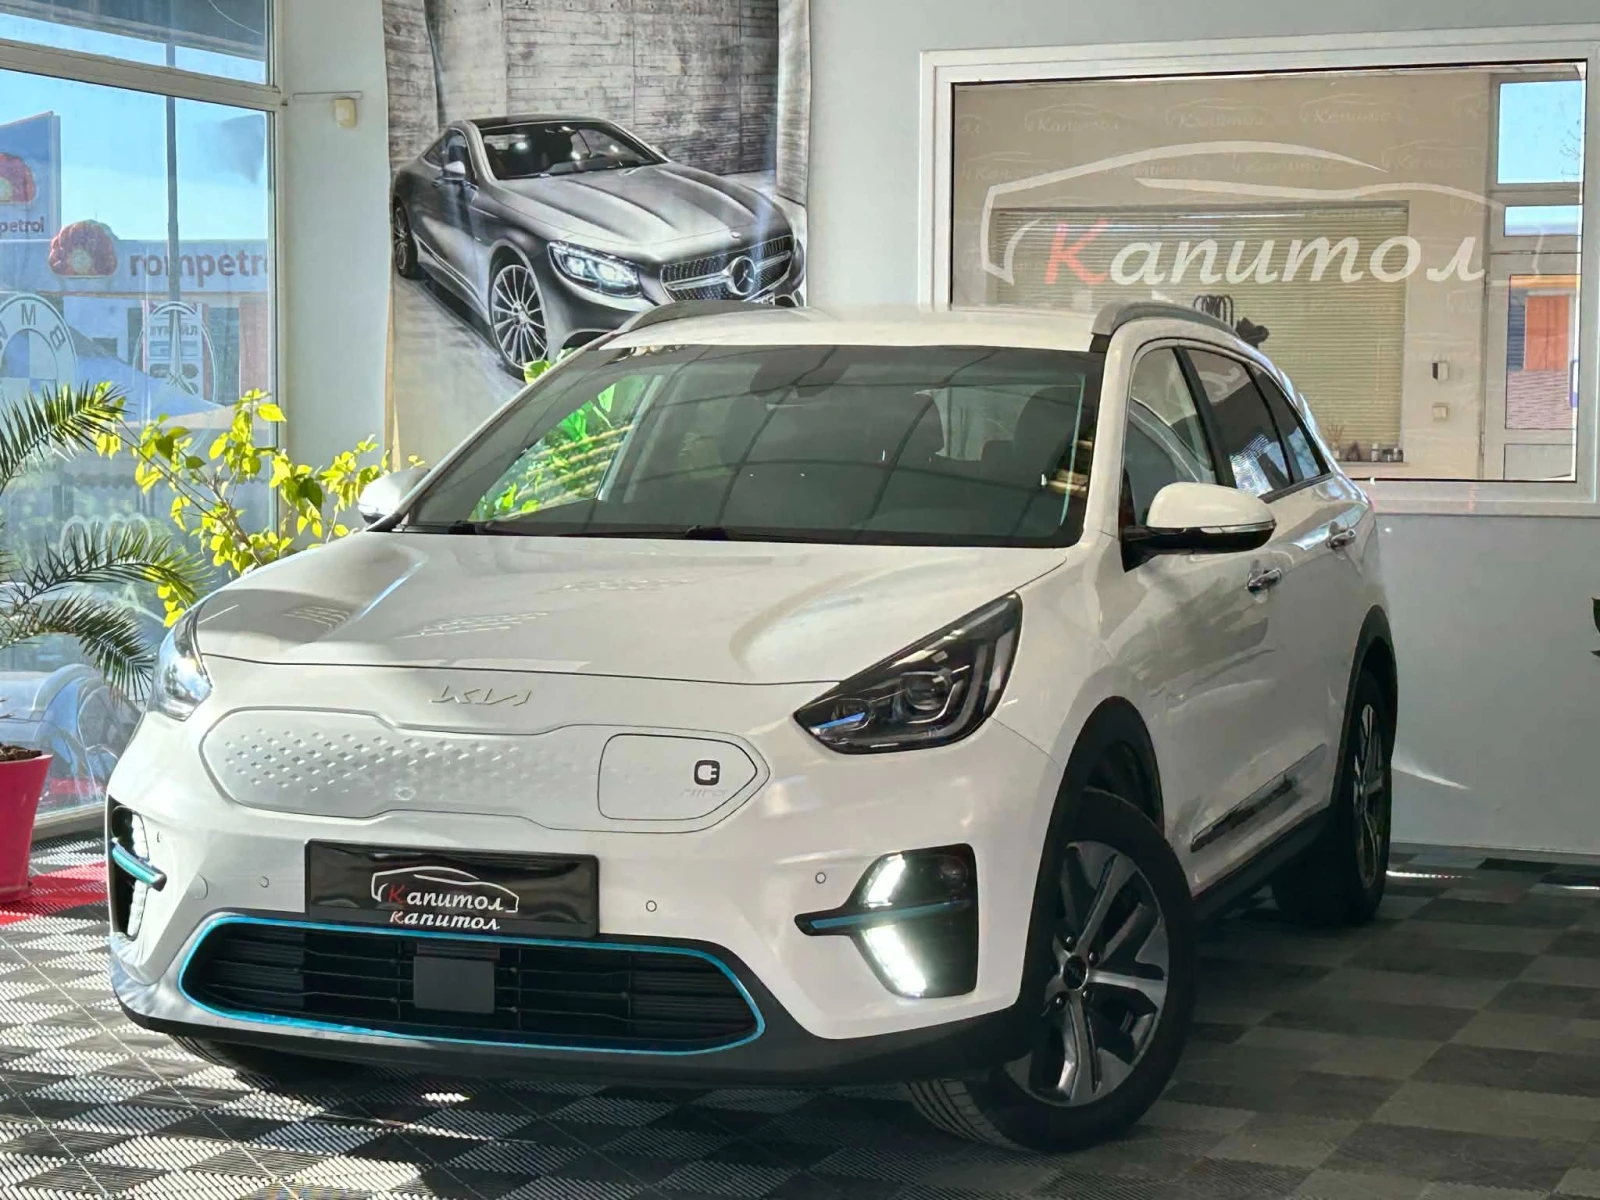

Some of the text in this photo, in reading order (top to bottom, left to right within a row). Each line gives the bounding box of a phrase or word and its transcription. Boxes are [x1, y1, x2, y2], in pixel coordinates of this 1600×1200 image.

[1043, 219, 1485, 285] Капитол
[388, 884, 504, 911] Капитол
[390, 910, 501, 931] Капитол
